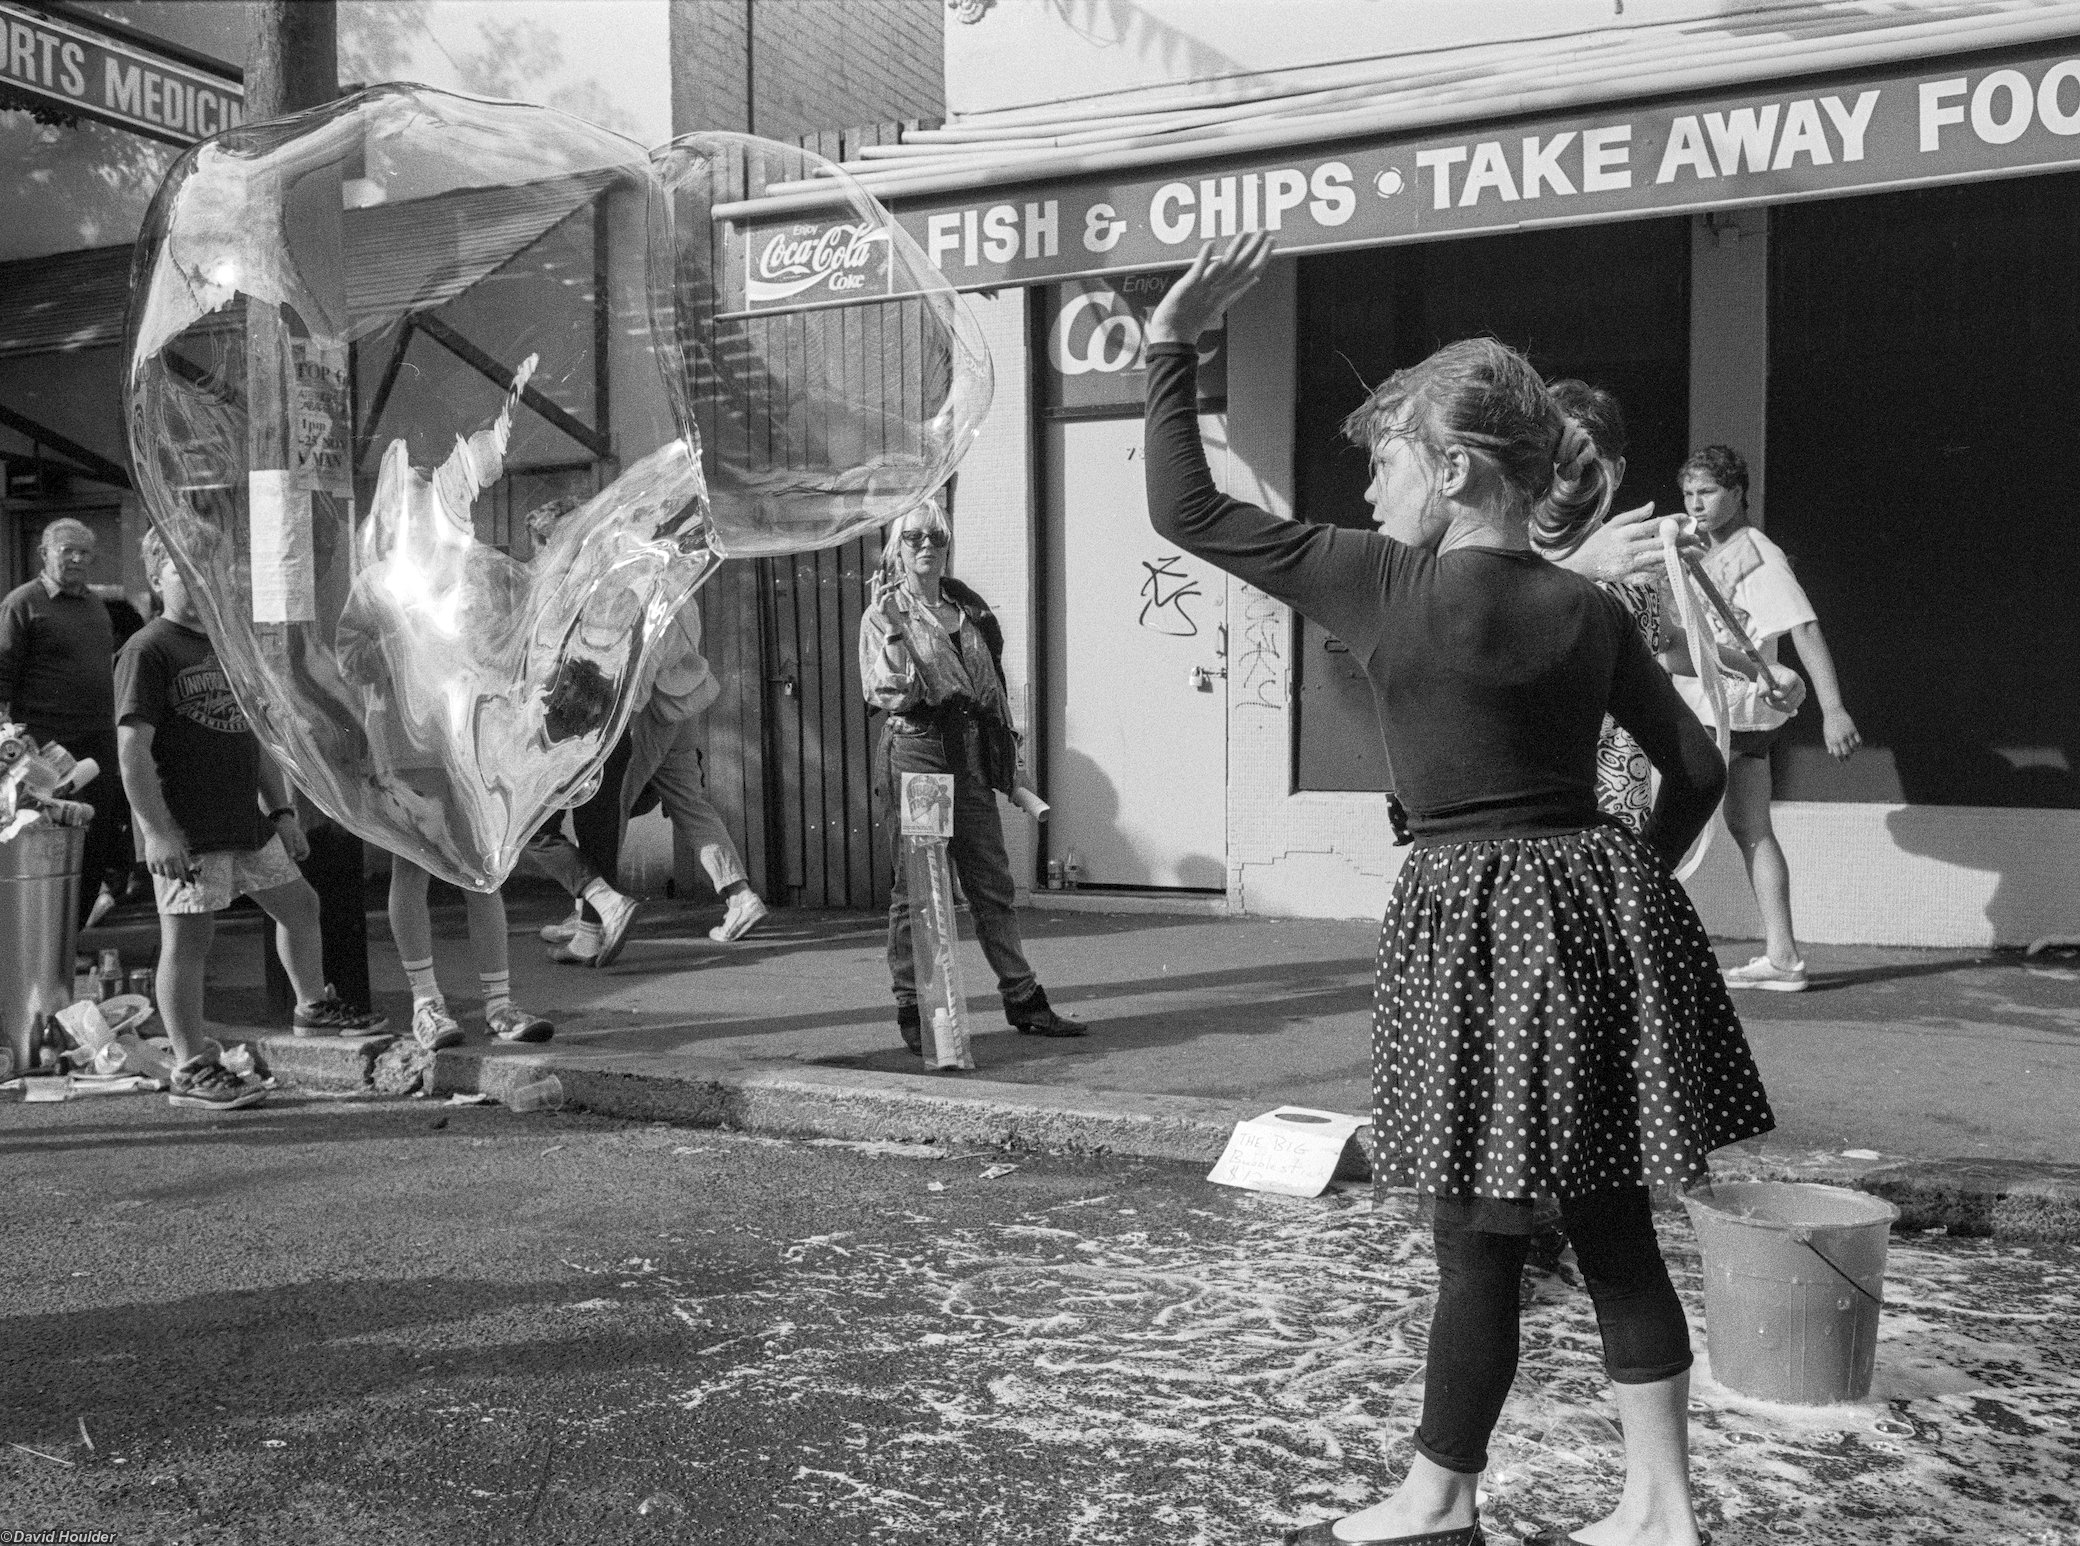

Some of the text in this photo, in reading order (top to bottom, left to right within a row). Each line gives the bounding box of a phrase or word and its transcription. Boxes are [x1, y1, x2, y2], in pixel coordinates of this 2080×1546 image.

[928, 200, 1060, 270] FISH
[1083, 204, 1127, 253] &
[1149, 162, 1356, 246] CHIPS
[1415, 124, 1633, 211] TAKE
[1655, 90, 1881, 184] AWAY
[793, 225, 818, 237] Enjoy
[760, 222, 874, 278] Coca-Cola
[828, 271, 865, 291] Coke
[1122, 274, 1170, 294] Enjoy
[1239, 1132, 1309, 1155] THE BIG
